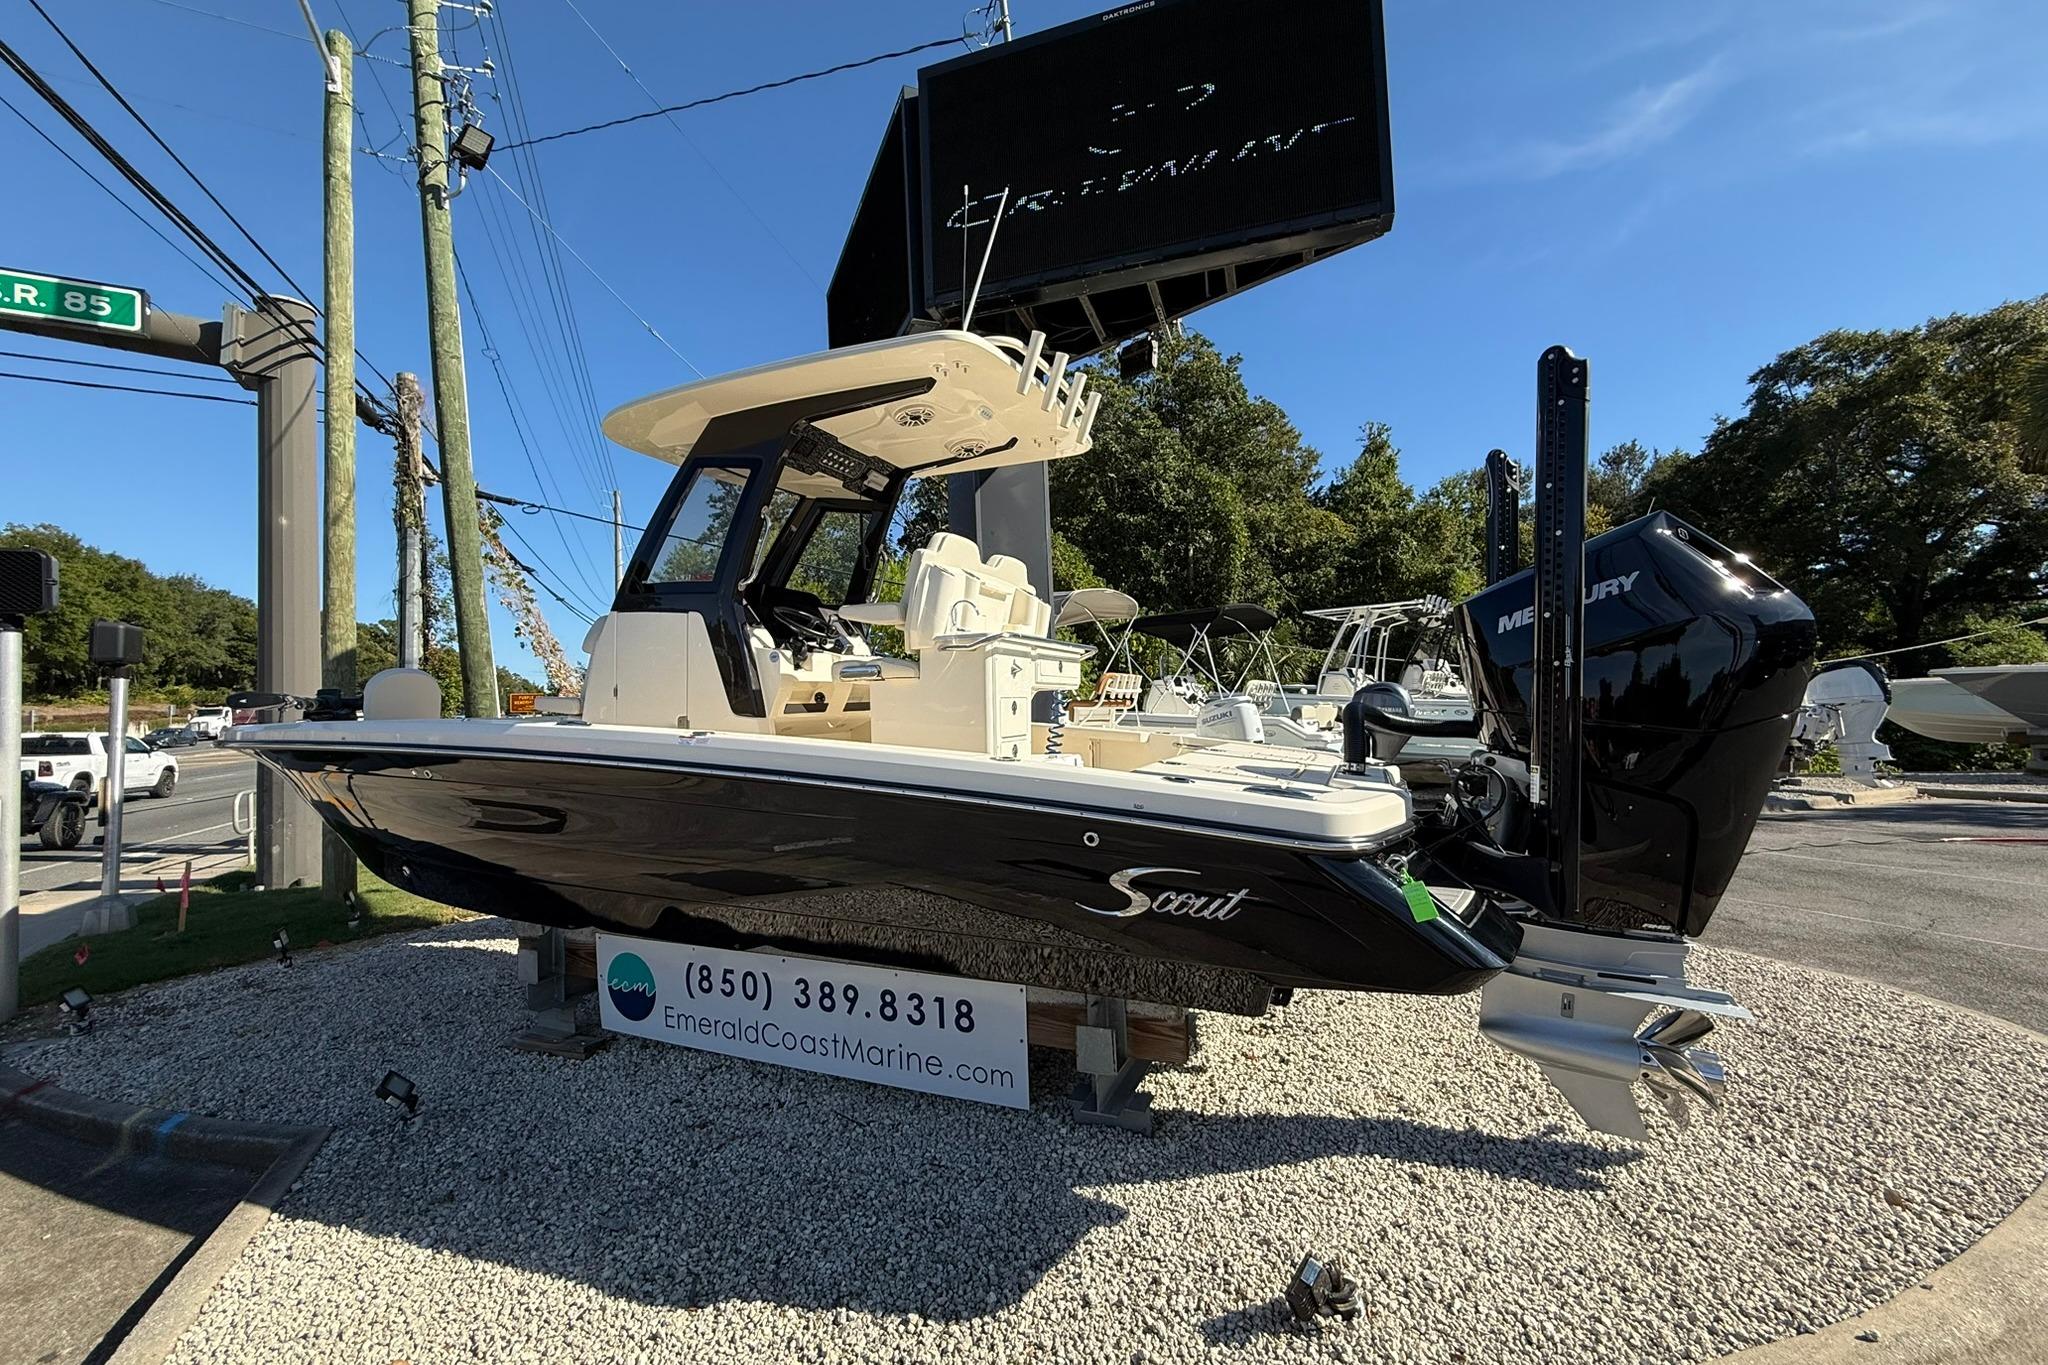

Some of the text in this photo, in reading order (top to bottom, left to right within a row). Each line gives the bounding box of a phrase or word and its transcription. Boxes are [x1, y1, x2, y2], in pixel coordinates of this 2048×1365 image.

[0, 282, 112, 316] .R. 85
[1497, 570, 1640, 634] MEURY
[1201, 710, 1233, 725] SUZUKI
[1075, 866, 1260, 921] Scout
[607, 977, 657, 997] ecm
[685, 962, 975, 1033] (850) 389.8318
[664, 1005, 1014, 1088] EmeraldCoastMarine.com
